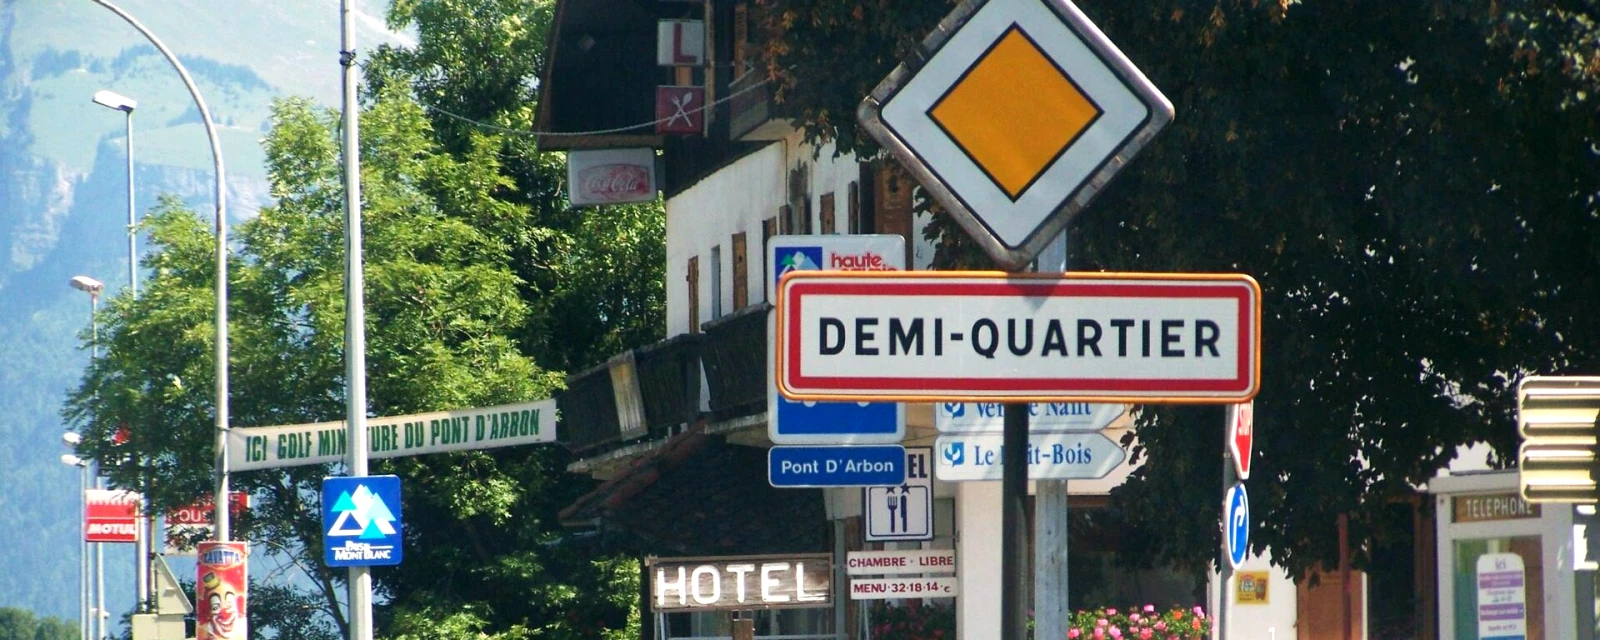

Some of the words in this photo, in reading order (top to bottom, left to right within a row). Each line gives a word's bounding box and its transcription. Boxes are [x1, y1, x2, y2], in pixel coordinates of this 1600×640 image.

[672, 22, 697, 63] L
[831, 252, 882, 269] haute
[819, 317, 1221, 359] DEMI-QUARTIER
[246, 435, 267, 462] ICI
[277, 432, 312, 460] GOLF
[318, 424, 399, 457] MINURE
[404, 421, 424, 449] DU
[431, 415, 470, 446] PONT
[475, 409, 540, 442] D'ARBON
[974, 445, 994, 465] Le
[781, 460, 819, 474] Pont
[826, 459, 894, 473] D'Arbon
[88, 523, 136, 535] MOTUL
[849, 556, 906, 567] CHAMBRE
[919, 556, 953, 566] LIBRE
[657, 562, 826, 605] HOTEL
